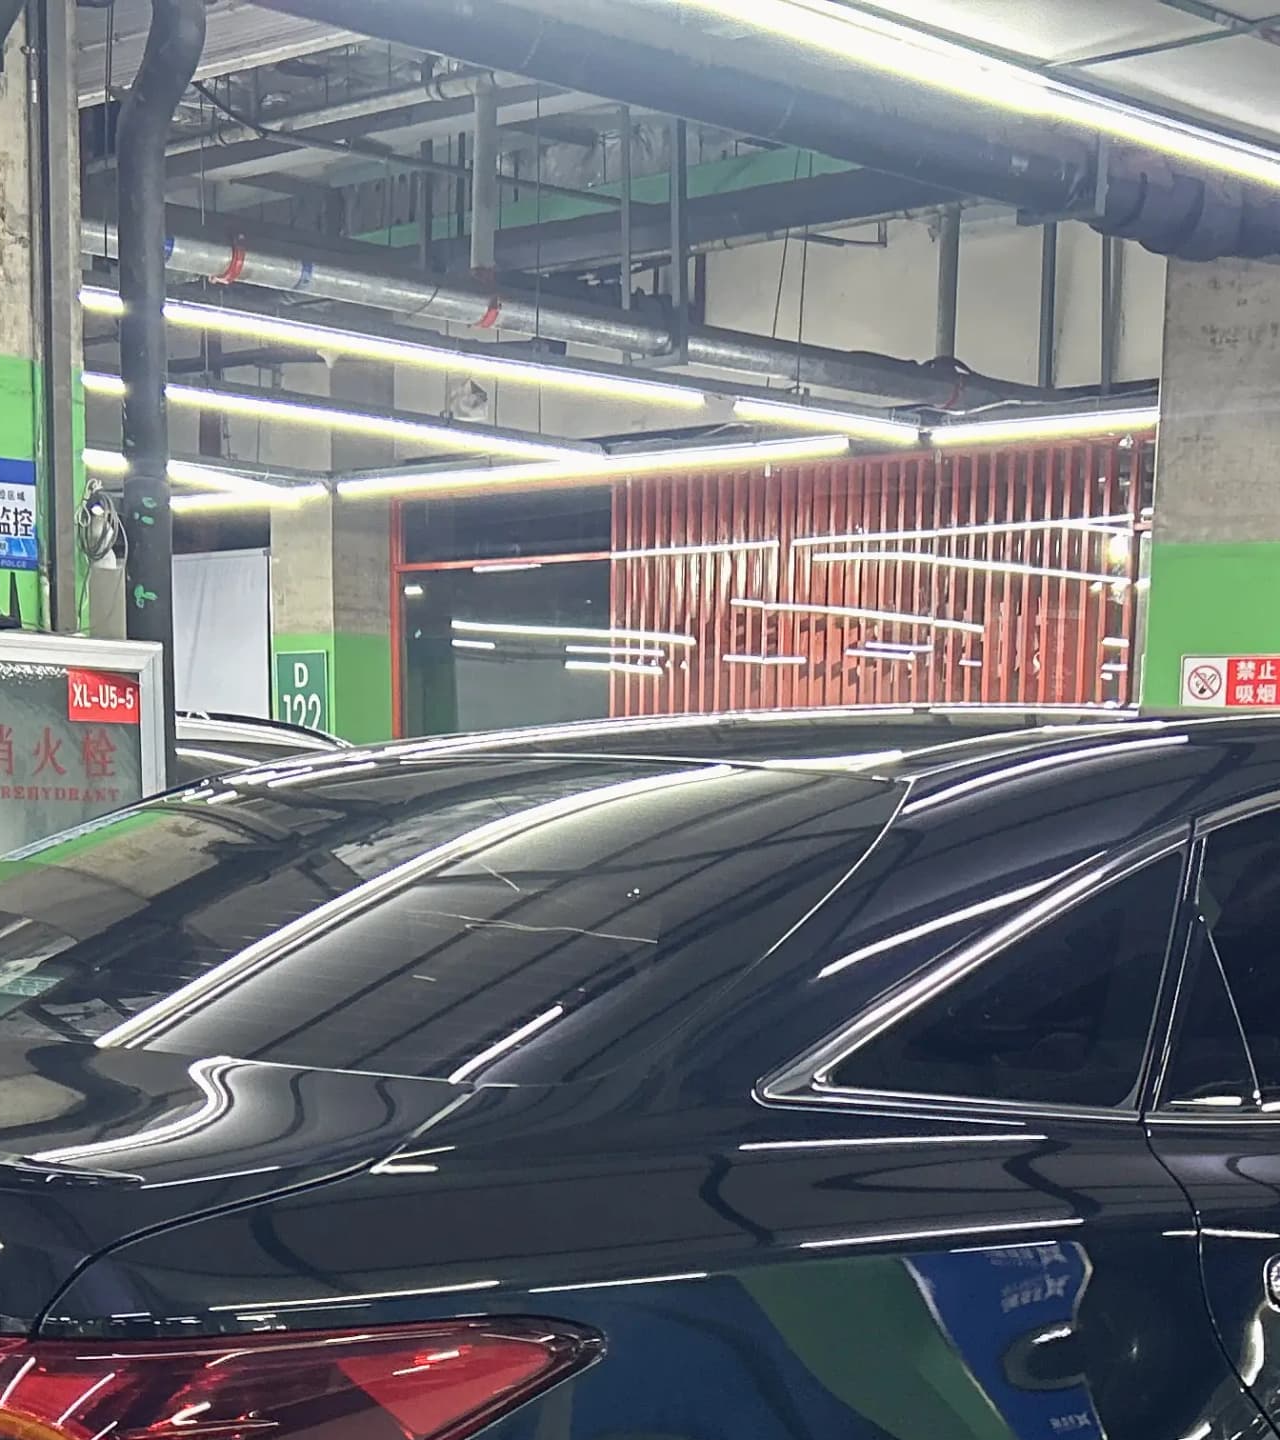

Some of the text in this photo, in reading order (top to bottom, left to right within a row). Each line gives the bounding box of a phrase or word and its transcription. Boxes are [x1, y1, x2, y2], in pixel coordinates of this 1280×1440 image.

[294, 662, 308, 688] D
[1236, 660, 1277, 681] 禁止
[72, 682, 135, 710] XL-U5-5
[1235, 683, 1277, 704] 吸烟
[283, 693, 322, 730] 122
